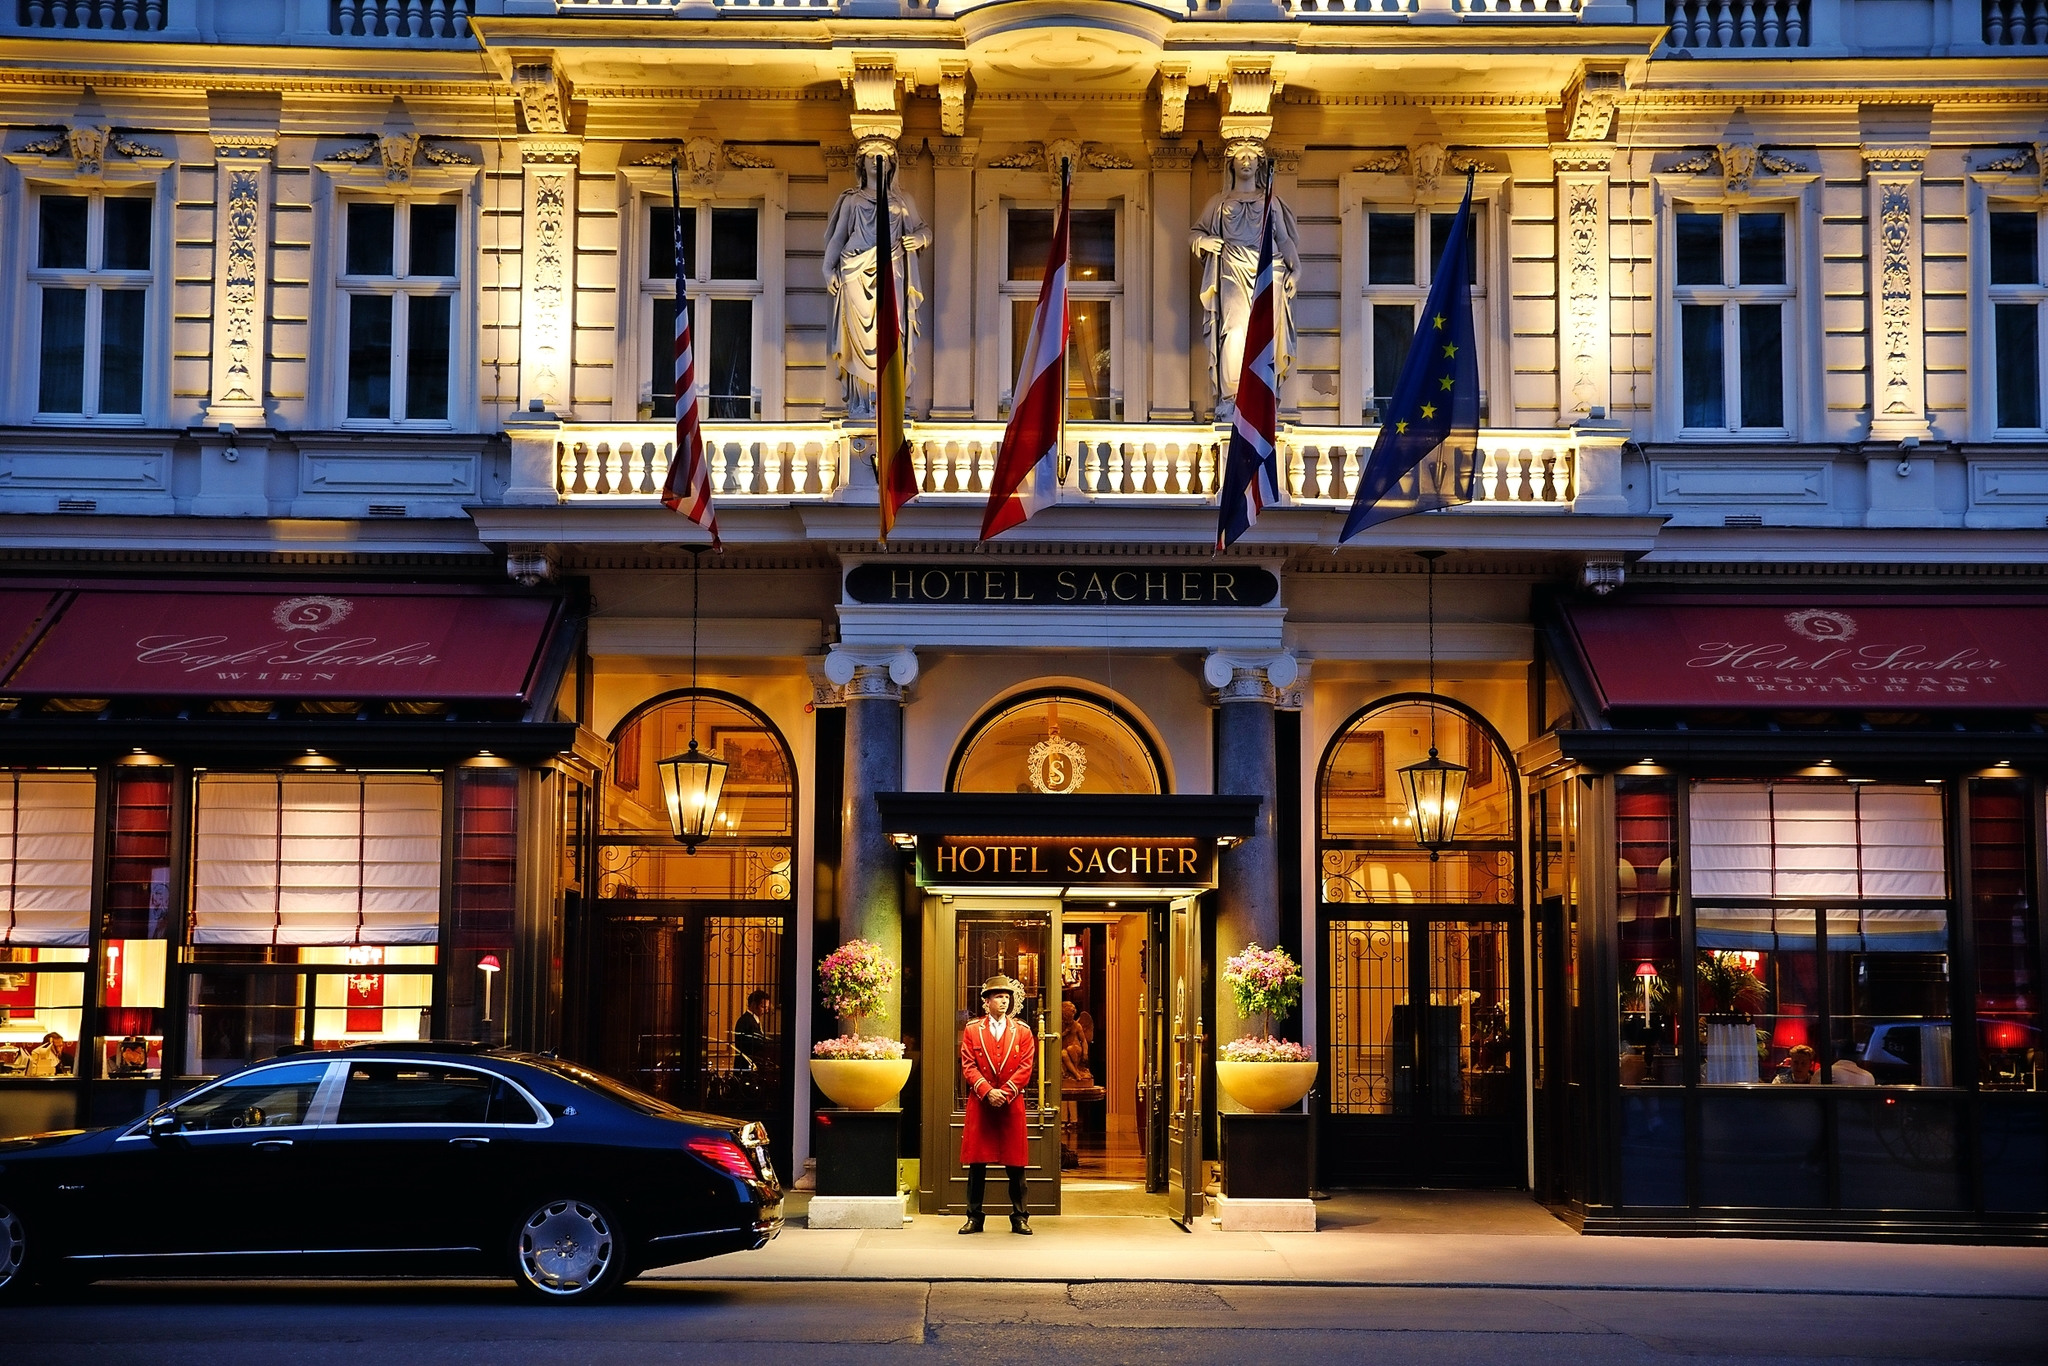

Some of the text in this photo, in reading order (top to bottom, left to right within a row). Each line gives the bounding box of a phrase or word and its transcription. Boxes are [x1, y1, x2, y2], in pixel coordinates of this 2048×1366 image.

[890, 570, 1239, 601] HOTEL SACHER
[298, 607, 321, 622] S
[1813, 620, 1834, 633] S
[136, 635, 441, 673] Café Sacher
[1686, 642, 2007, 670] Hotel Sacher
[216, 672, 337, 680] WIEN
[1714, 675, 1997, 684] RESTAURANT
[1754, 684, 1862, 692] ROTE
[1050, 760, 1065, 785] S
[936, 846, 1198, 874] HOTEL SACHER
